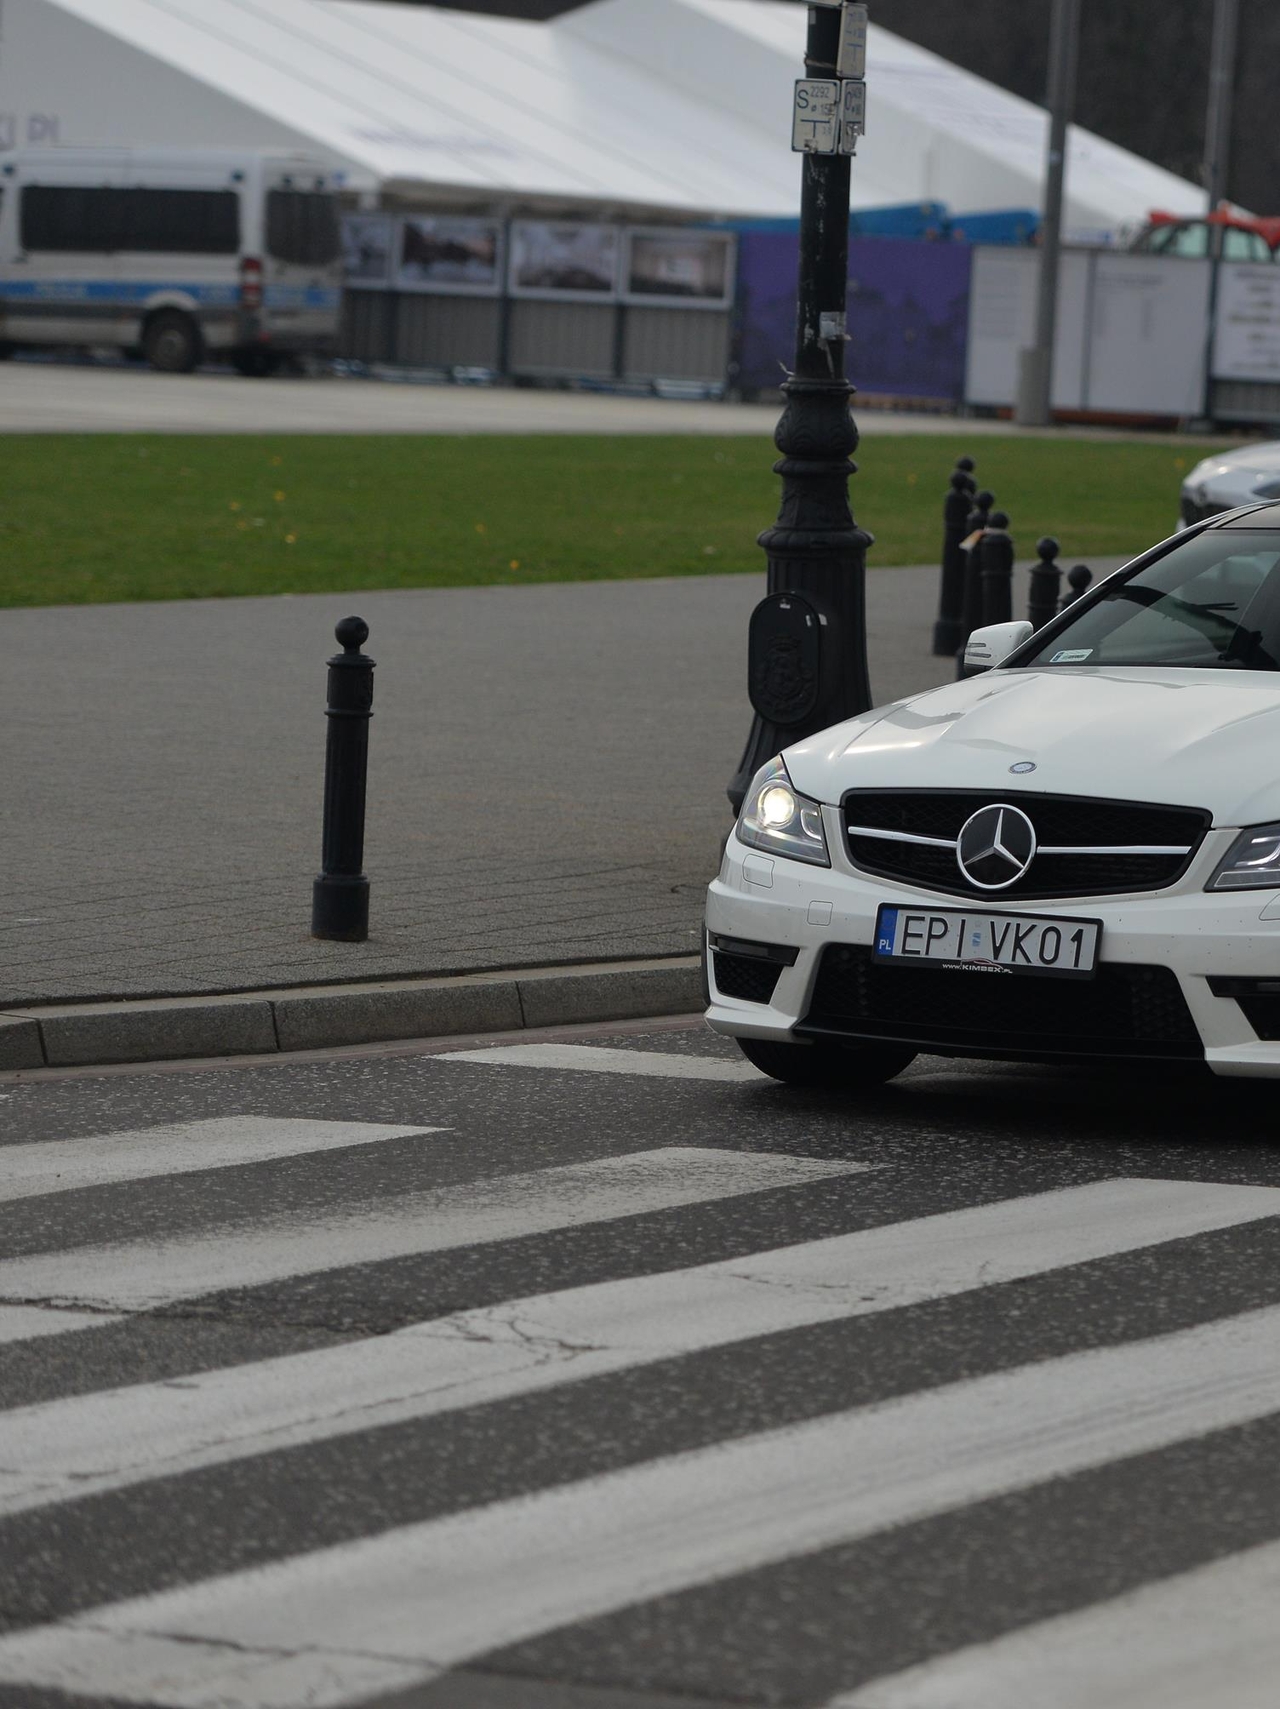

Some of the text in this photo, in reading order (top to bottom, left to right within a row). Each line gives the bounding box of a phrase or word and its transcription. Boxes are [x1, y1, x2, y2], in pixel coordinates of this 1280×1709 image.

[797, 85, 830, 109] S 2292
[878, 939, 892, 951] PL
[901, 915, 1085, 968] EPI VK01
